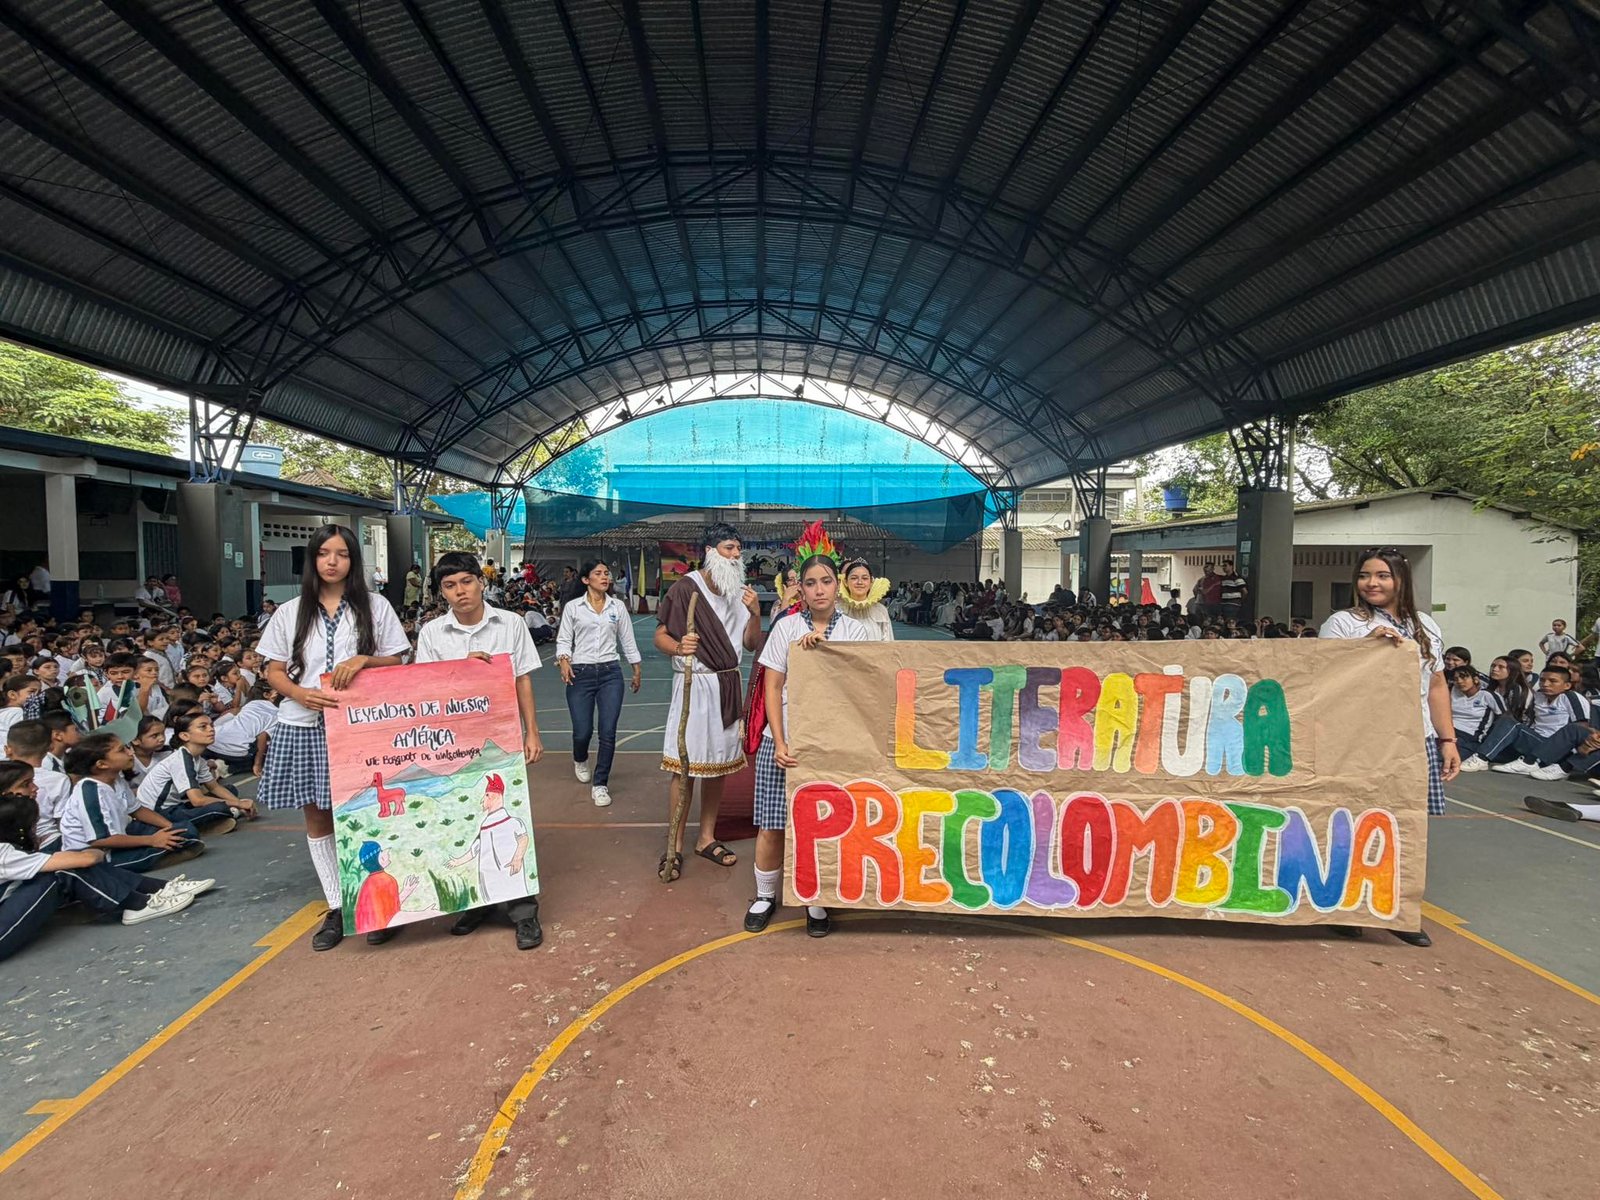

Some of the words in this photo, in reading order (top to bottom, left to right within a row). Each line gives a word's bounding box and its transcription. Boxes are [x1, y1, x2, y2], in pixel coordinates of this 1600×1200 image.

[347, 702, 416, 724] LEYENDAS
[420, 701, 439, 716] DE
[445, 696, 490, 715] NUESTRA
[393, 725, 455, 751] AMÉRICA
[894, 664, 1293, 777] LITERATURA
[790, 780, 1401, 921] PRECOLOMBINA
